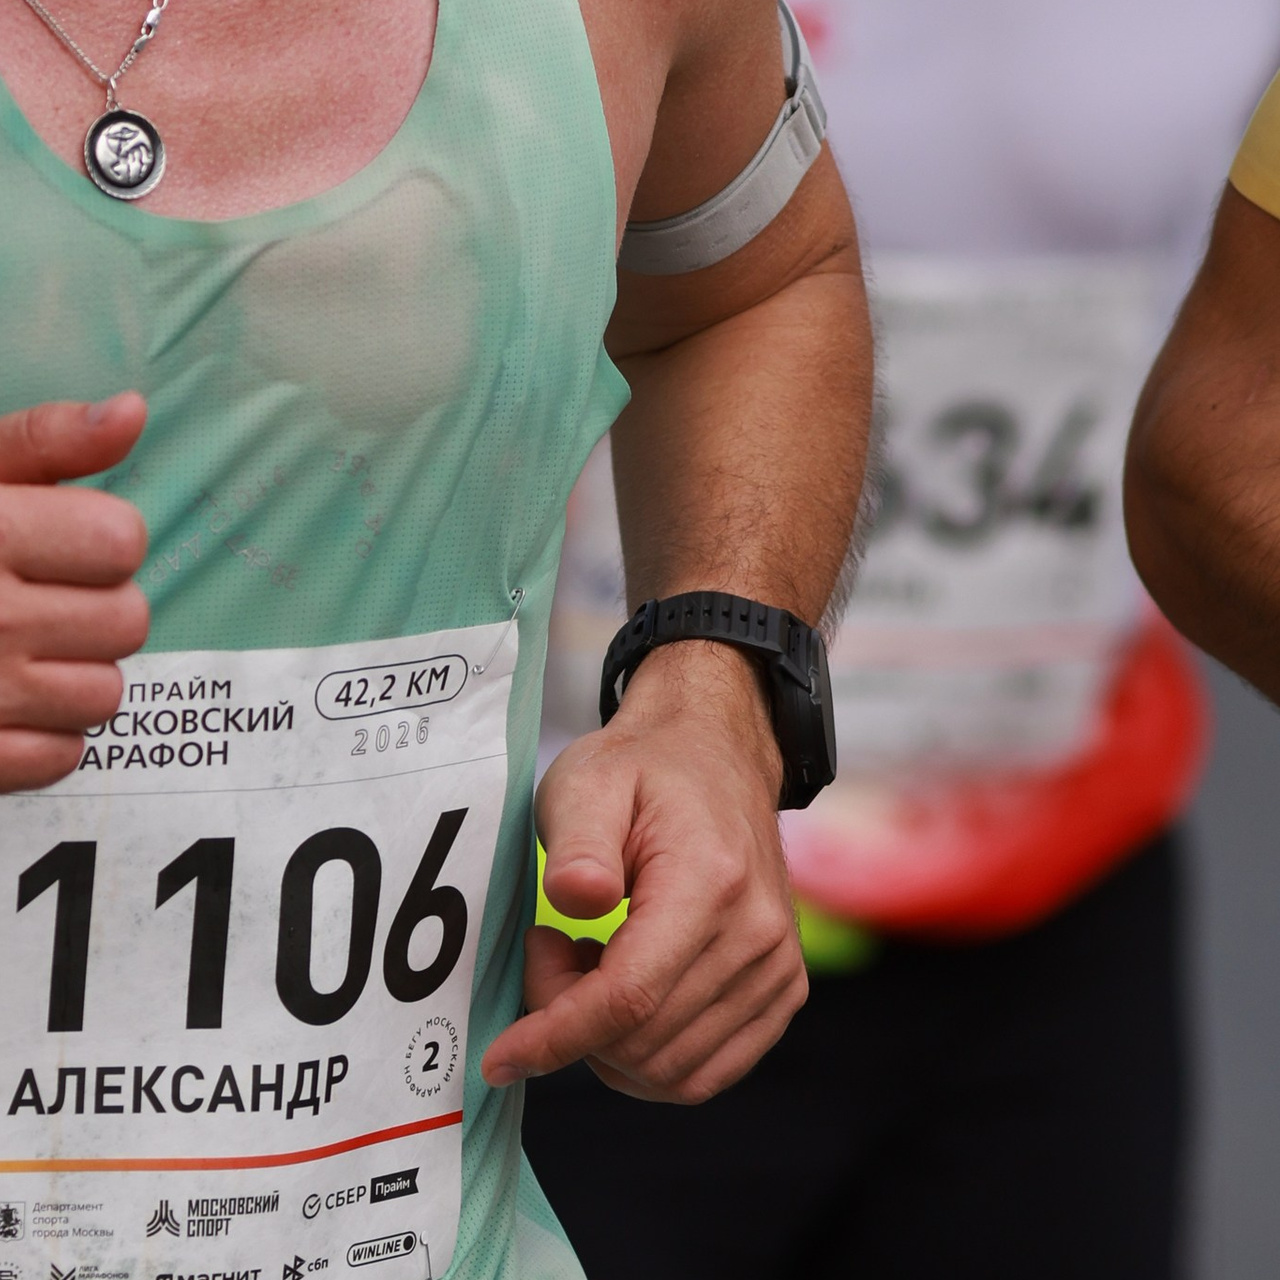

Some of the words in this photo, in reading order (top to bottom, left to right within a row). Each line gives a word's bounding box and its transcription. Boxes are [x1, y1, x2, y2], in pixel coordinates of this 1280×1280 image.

[128, 675, 232, 703] ПРАЙМ
[334, 674, 397, 708] 42,2
[83, 700, 295, 738] СКОВСКИЙ
[350, 716, 430, 756] 2026
[77, 740, 229, 771] АРАФОН
[422, 1041, 440, 1072] 2
[7, 1053, 350, 1120] АЛЕКСАНДР
[187, 1190, 280, 1218] МОСКОВСКИЙ
[325, 1185, 367, 1210] СБЕР
[375, 1177, 411, 1197] Прайм
[32, 1202, 104, 1214] Департамент
[32, 1216, 69, 1227] спорта
[32, 1229, 69, 1240] города
[72, 1228, 114, 1238] Москвы
[187, 1218, 232, 1238] СПОРТ
[352, 1239, 402, 1262] WINLINE
[307, 1258, 329, 1272] сбп
